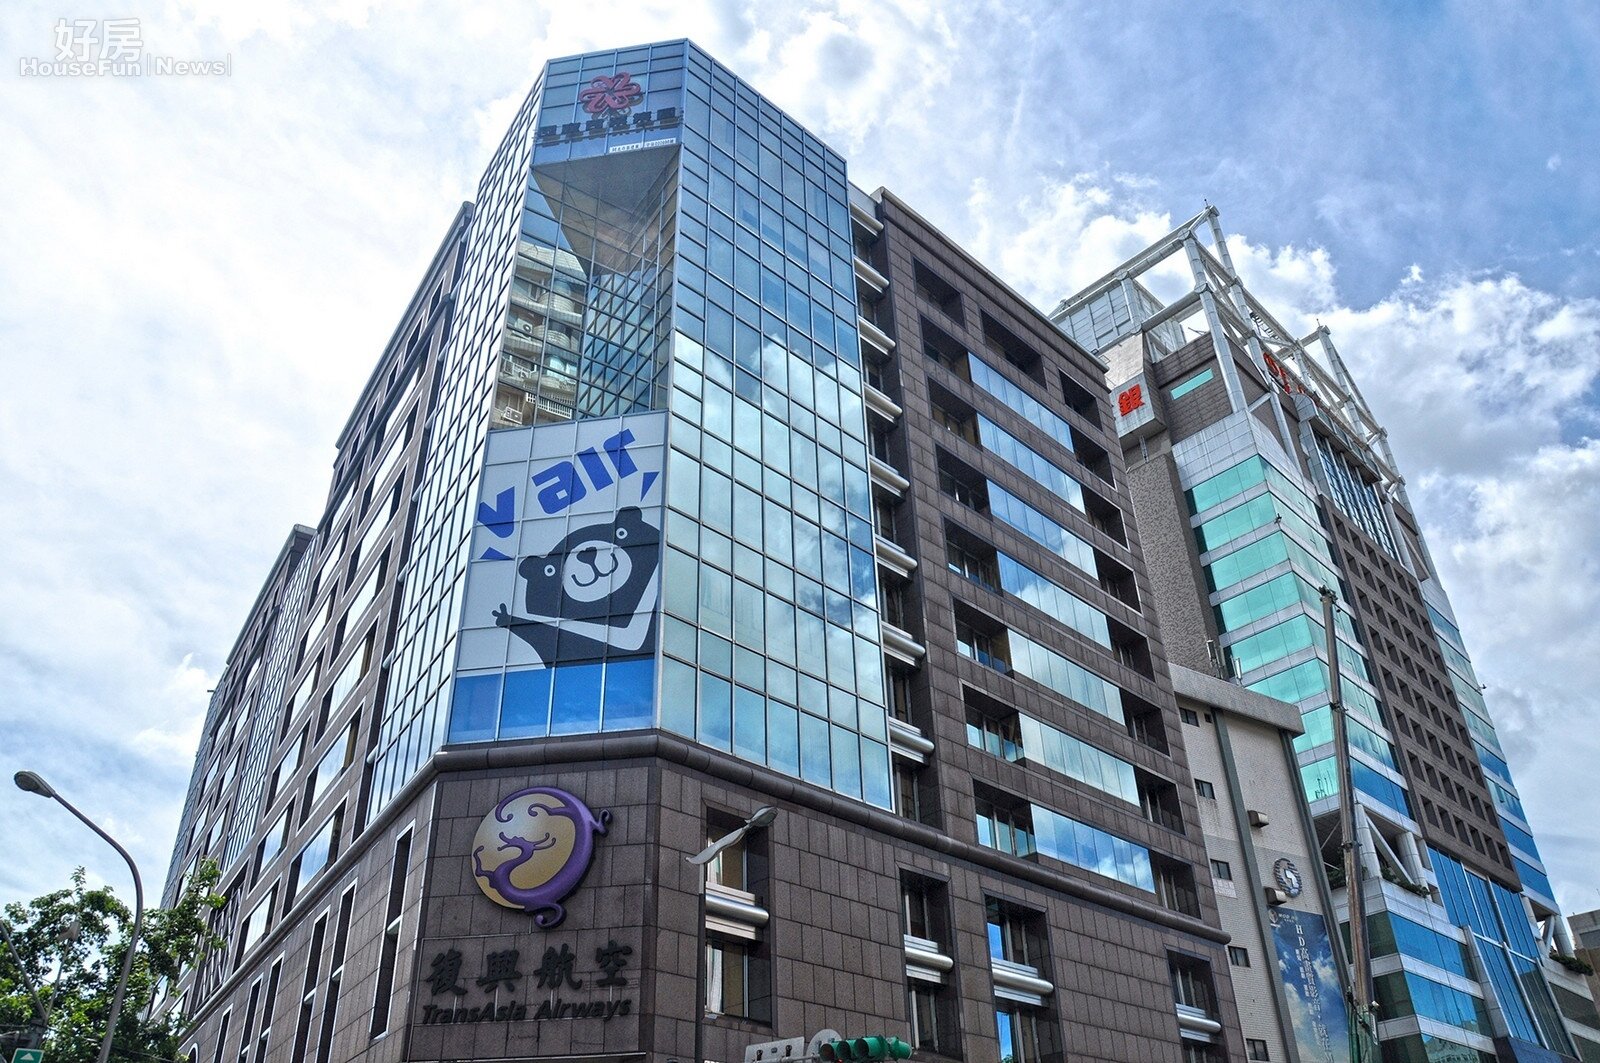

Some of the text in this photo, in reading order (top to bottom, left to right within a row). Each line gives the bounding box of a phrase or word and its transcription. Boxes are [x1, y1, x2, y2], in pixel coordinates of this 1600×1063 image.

[1118, 384, 1145, 416] 銀
[531, 428, 638, 515] air
[425, 939, 633, 996] 復興航空
[423, 998, 632, 1024] TransAsia Airways
